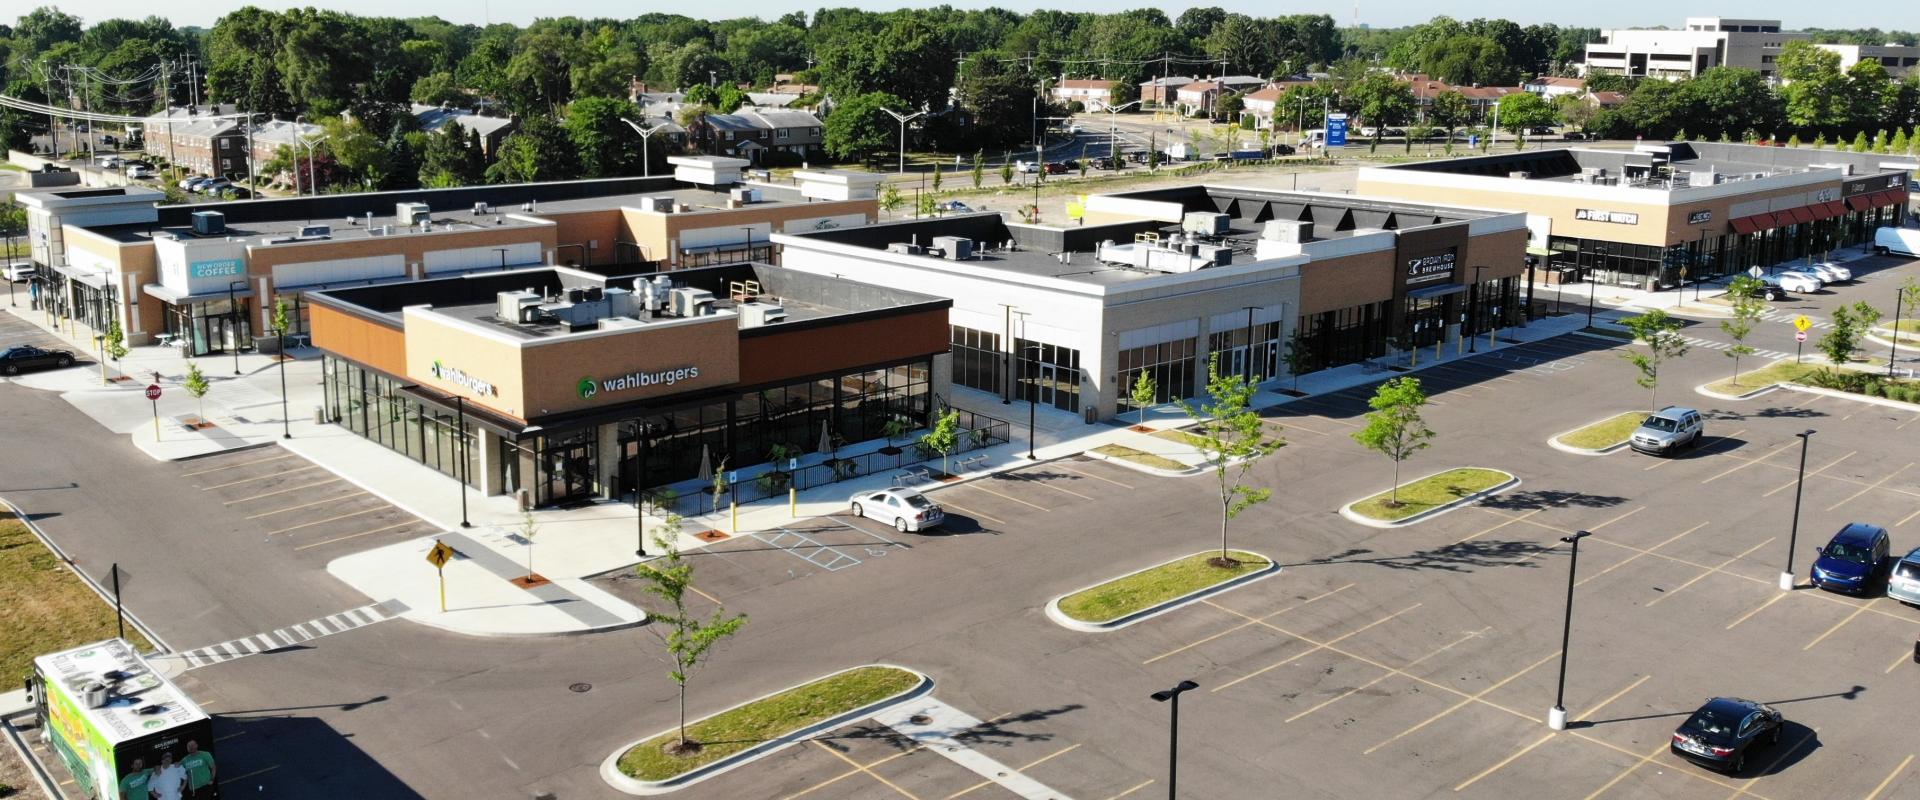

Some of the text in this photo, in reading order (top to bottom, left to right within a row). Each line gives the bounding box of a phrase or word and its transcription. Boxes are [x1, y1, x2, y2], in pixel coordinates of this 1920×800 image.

[1587, 211, 1609, 222] FIRST
[197, 267, 237, 277] COFFEE
[1422, 262, 1453, 274] BREWHOUSE
[439, 367, 493, 396] wahlburgers
[603, 366, 698, 392] wahlburgers
[146, 389, 161, 397] STOP
